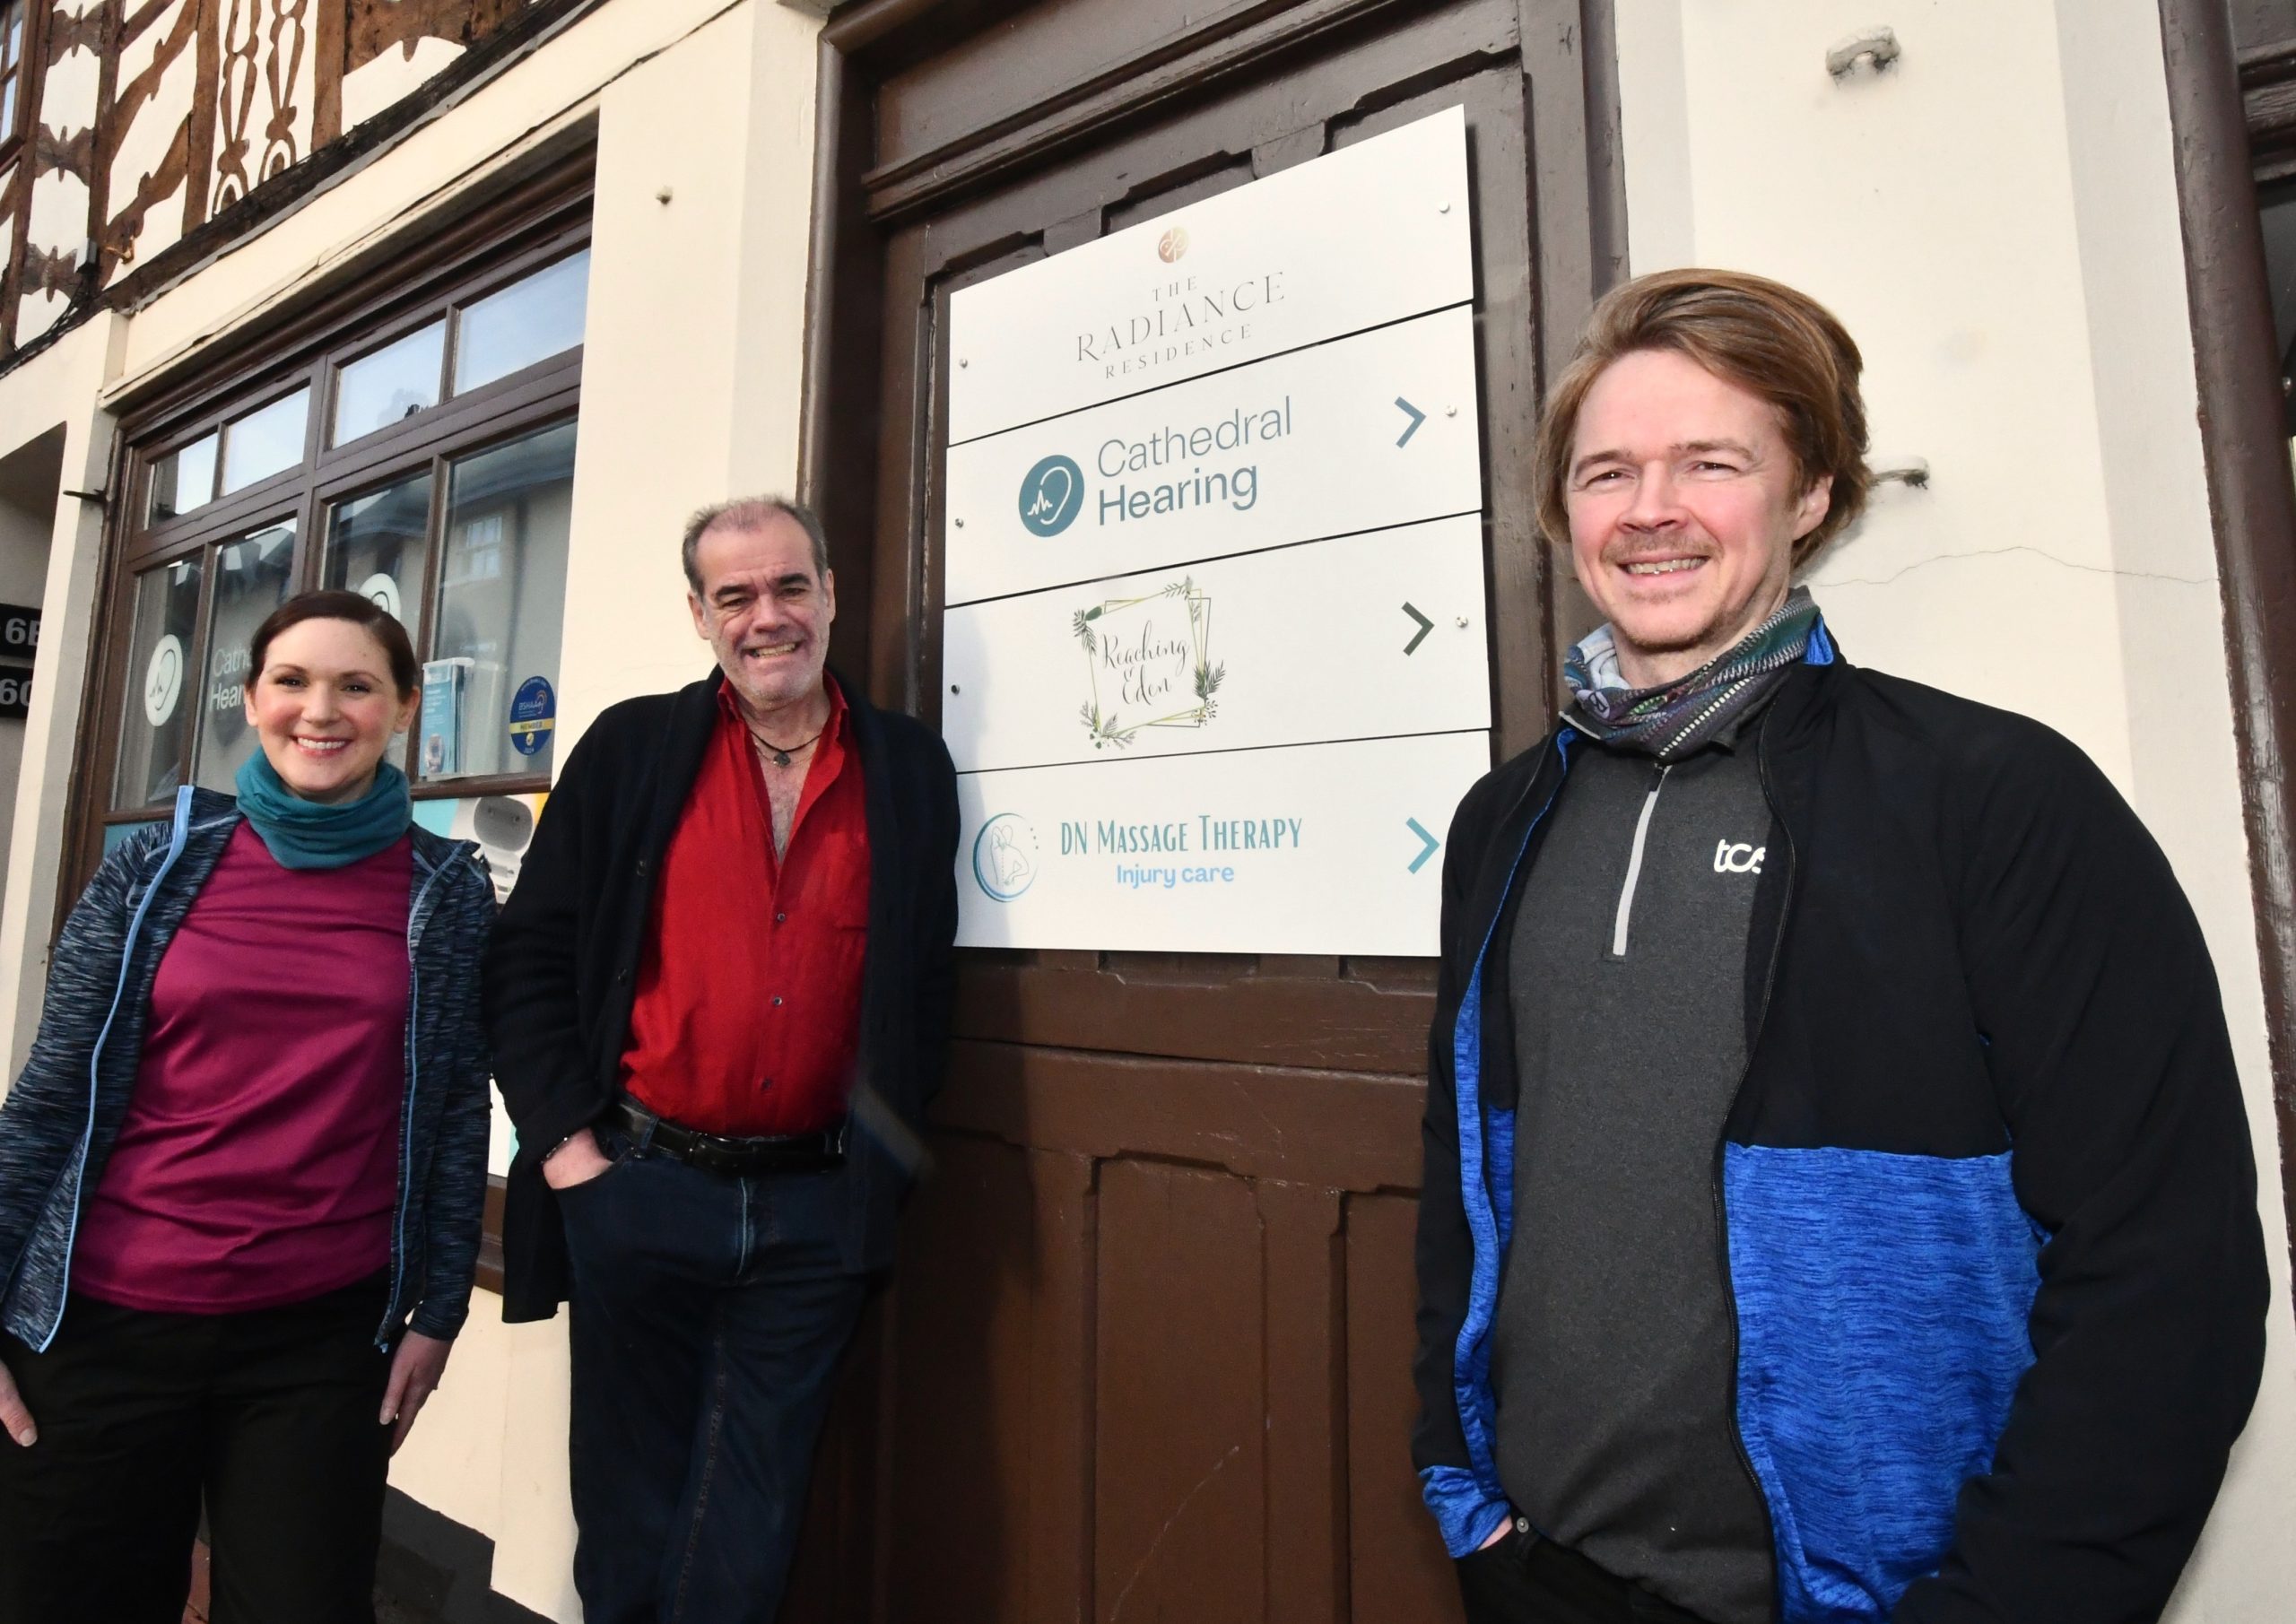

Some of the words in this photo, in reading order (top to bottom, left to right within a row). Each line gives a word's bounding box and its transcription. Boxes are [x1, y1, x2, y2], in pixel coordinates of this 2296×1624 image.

[1077, 272, 1284, 361] RADIANCE
[1152, 276, 1197, 302] THE
[1106, 323, 1251, 378] RESIDENCE
[1098, 395, 1291, 477] Cathedral
[1100, 465, 1257, 525] Hearing
[1102, 620, 1190, 676] Reaching
[1122, 664, 1171, 706] Eden
[1061, 821, 1087, 855] DN
[1097, 820, 1189, 855] MASSAGE
[1198, 815, 1302, 851] THERAPY
[1117, 864, 1176, 889] Injury
[1181, 865, 1234, 883] care
